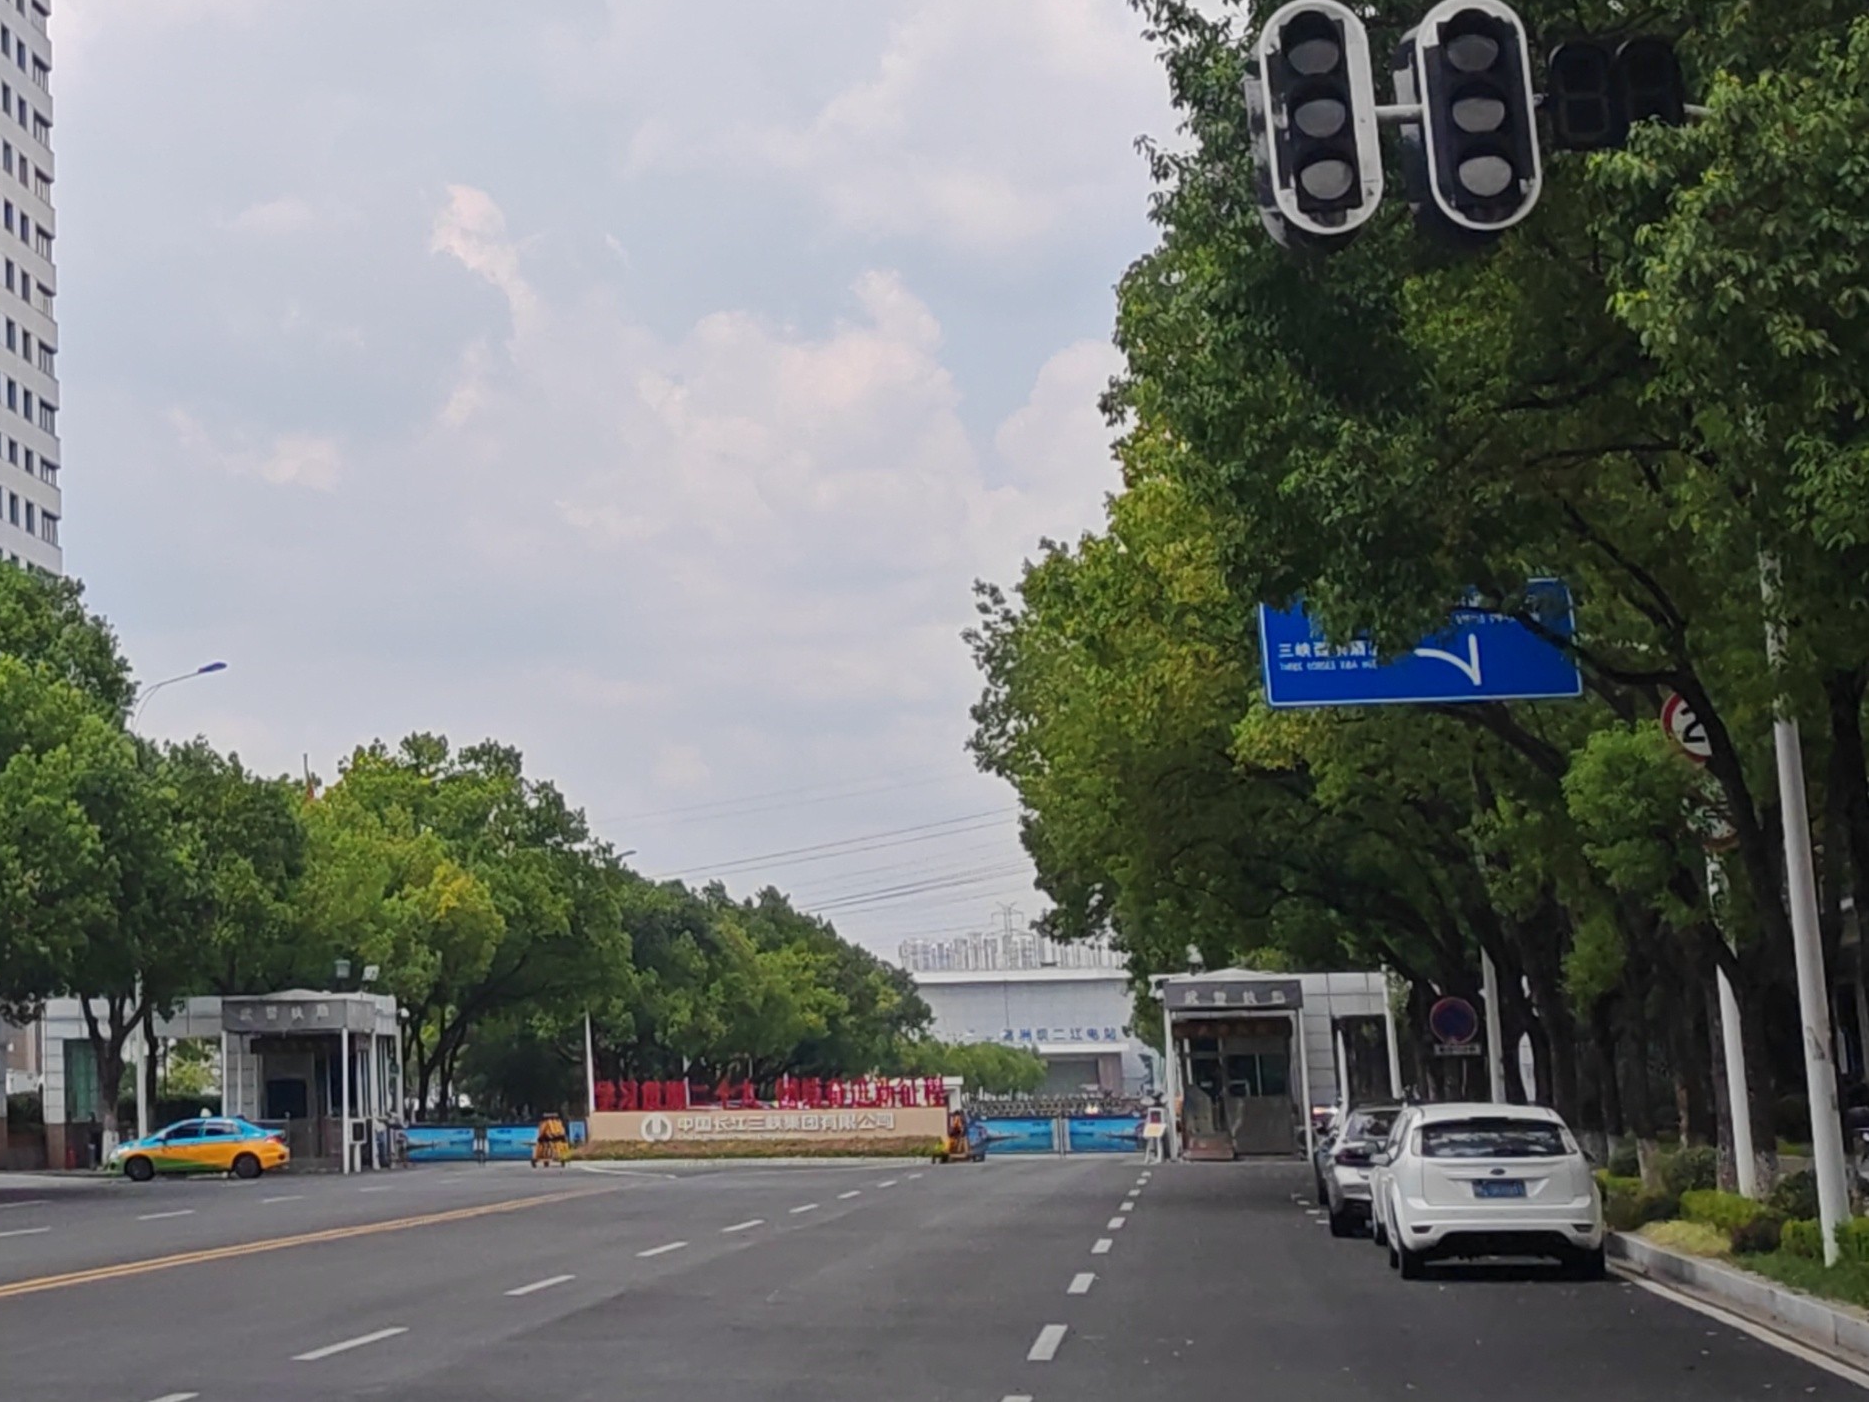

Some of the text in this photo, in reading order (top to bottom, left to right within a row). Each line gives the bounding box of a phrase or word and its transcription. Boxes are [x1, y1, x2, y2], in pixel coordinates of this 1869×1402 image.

[678, 1112, 894, 1133] 中国长江三峡集团有限公司
